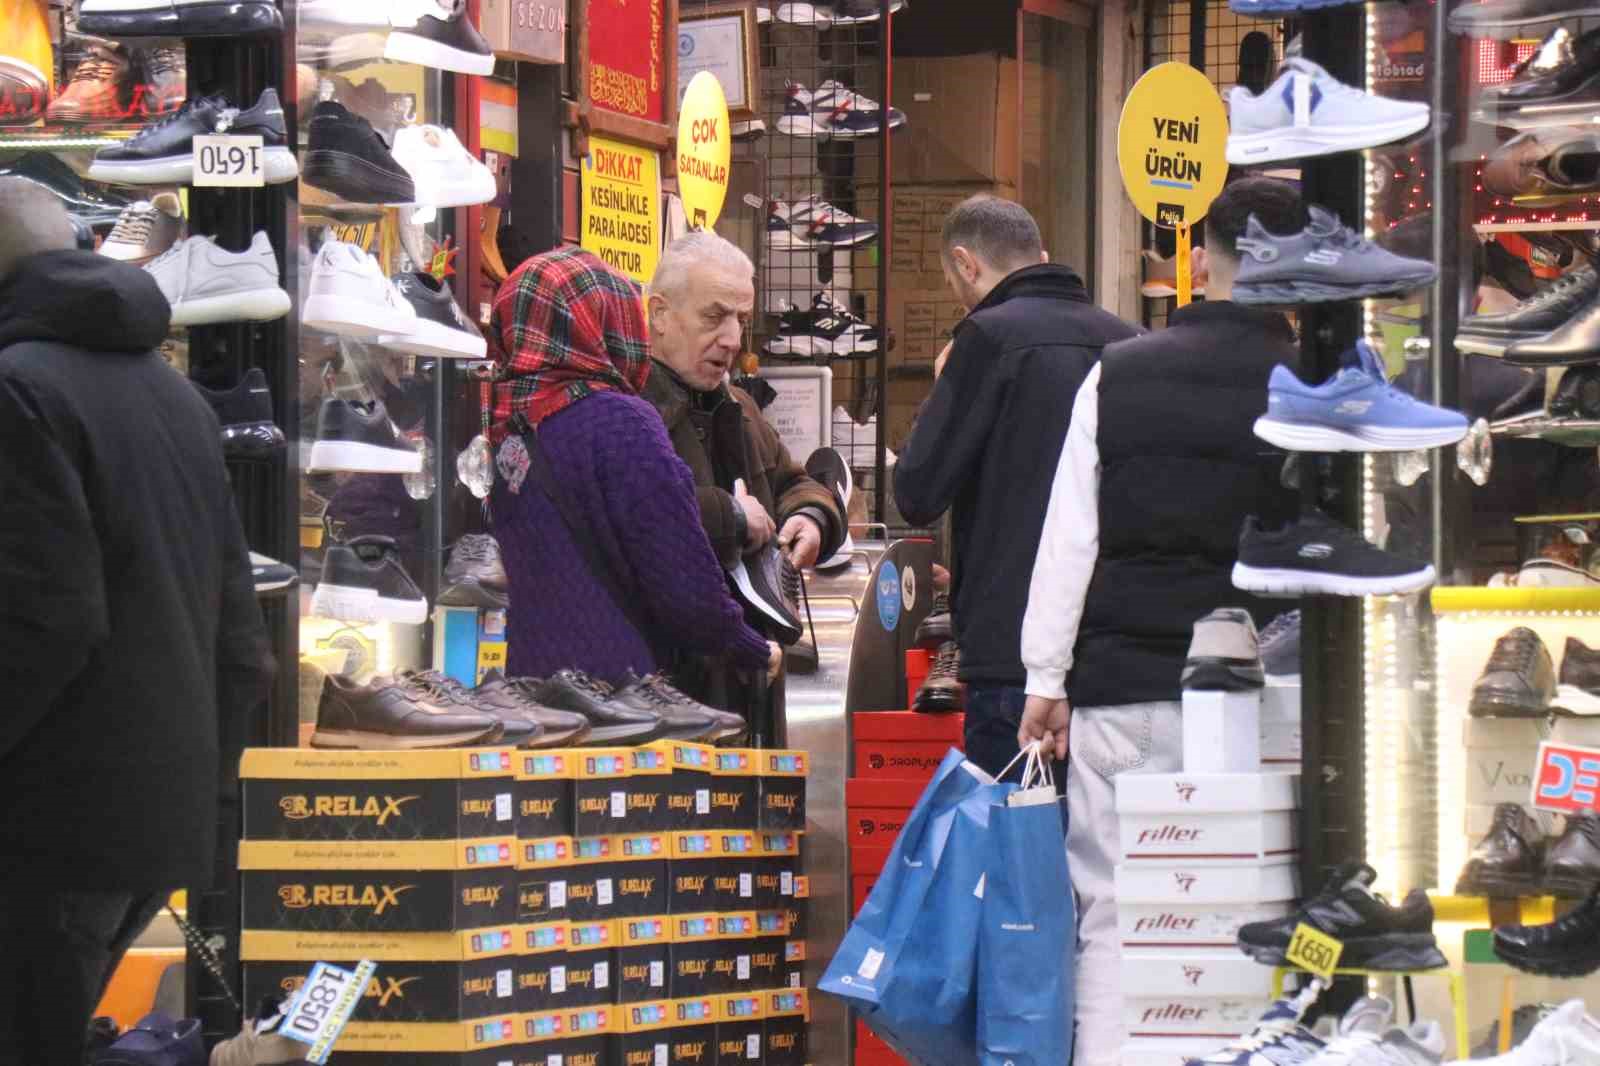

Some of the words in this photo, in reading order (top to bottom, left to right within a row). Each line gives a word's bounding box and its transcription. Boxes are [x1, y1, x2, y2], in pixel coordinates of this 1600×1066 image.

[691, 118, 718, 145] ÇOK
[1153, 116, 1199, 144] YENİ
[679, 154, 727, 186] SATANLAR
[1145, 147, 1202, 182] ÜRÜN
[590, 183, 649, 216] KESİNLİKLE
[588, 214, 616, 238] PARA
[616, 215, 652, 246] İADESİ
[599, 247, 642, 273] YOKTUR
